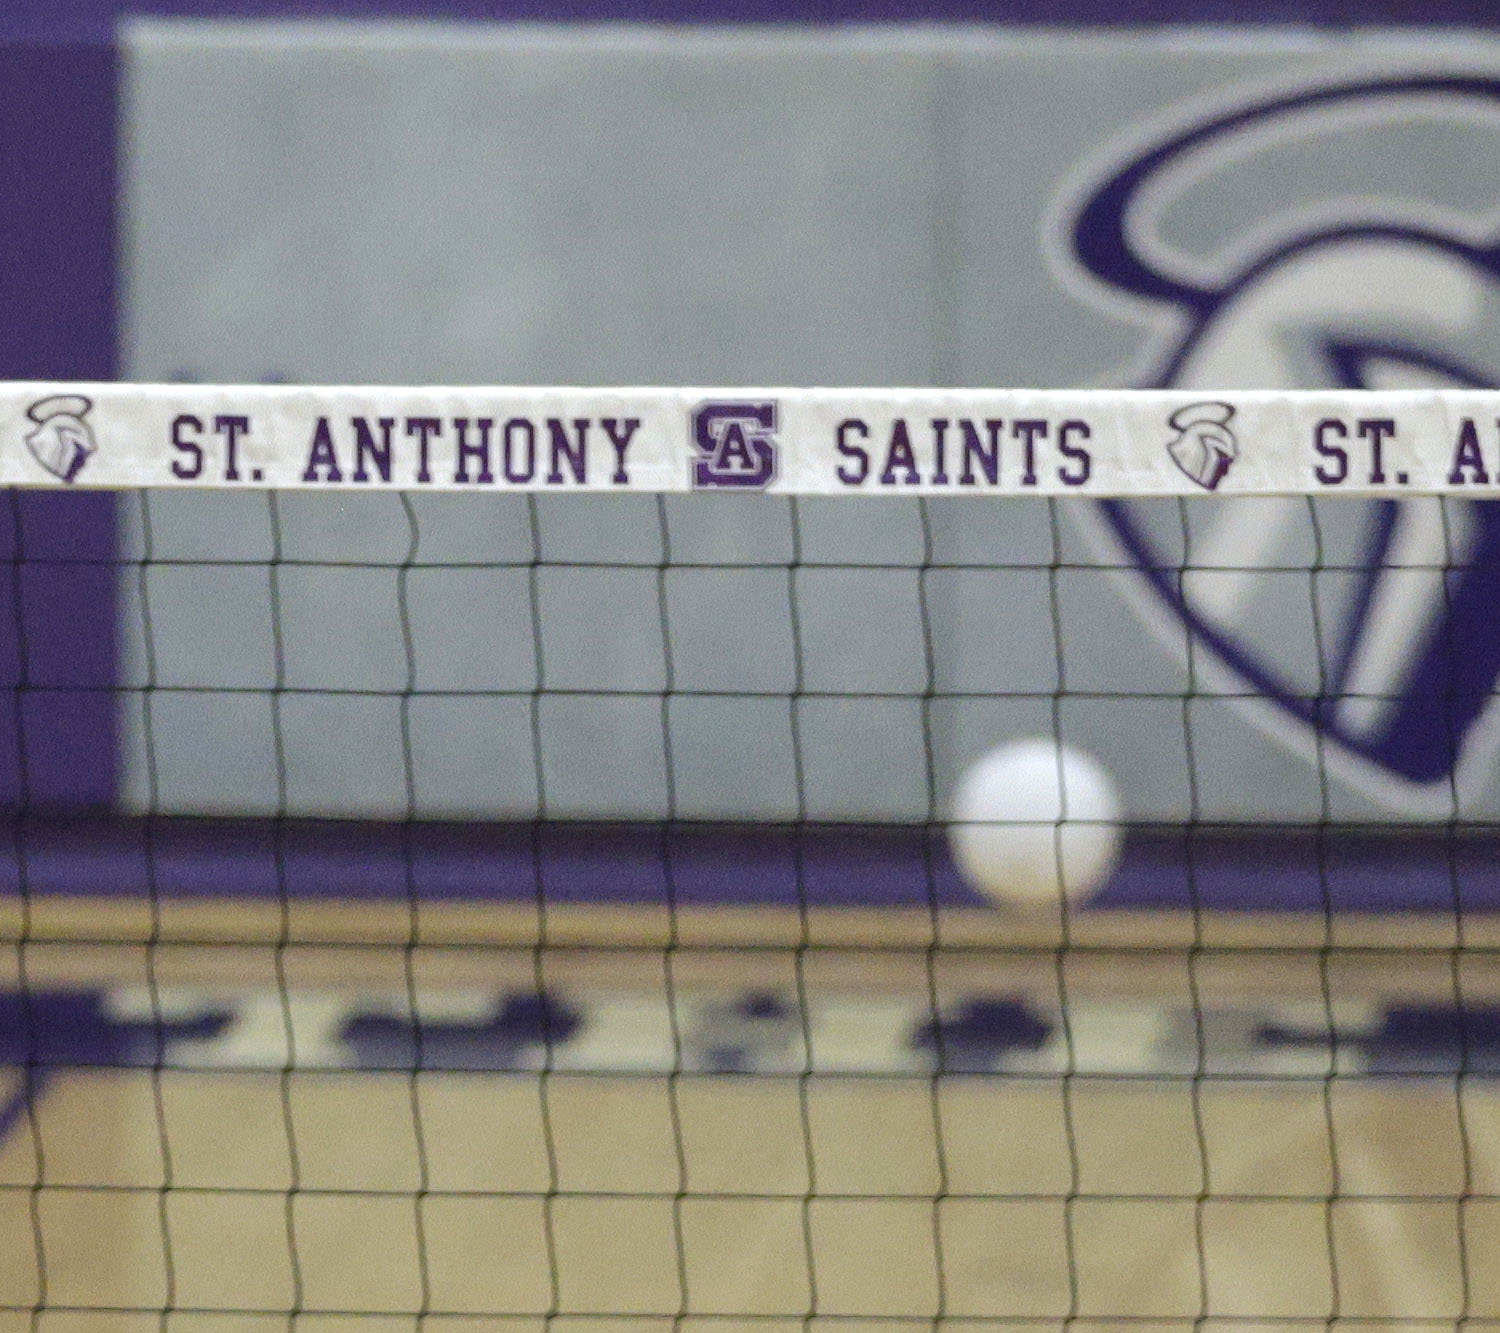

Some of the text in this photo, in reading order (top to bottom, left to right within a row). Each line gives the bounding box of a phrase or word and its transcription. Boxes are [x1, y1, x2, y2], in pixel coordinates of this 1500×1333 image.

[170, 413, 264, 482] ST.
[301, 415, 642, 486] ANTHONY
[835, 417, 1093, 488] SAINTS
[1313, 417, 1410, 486] ST.
